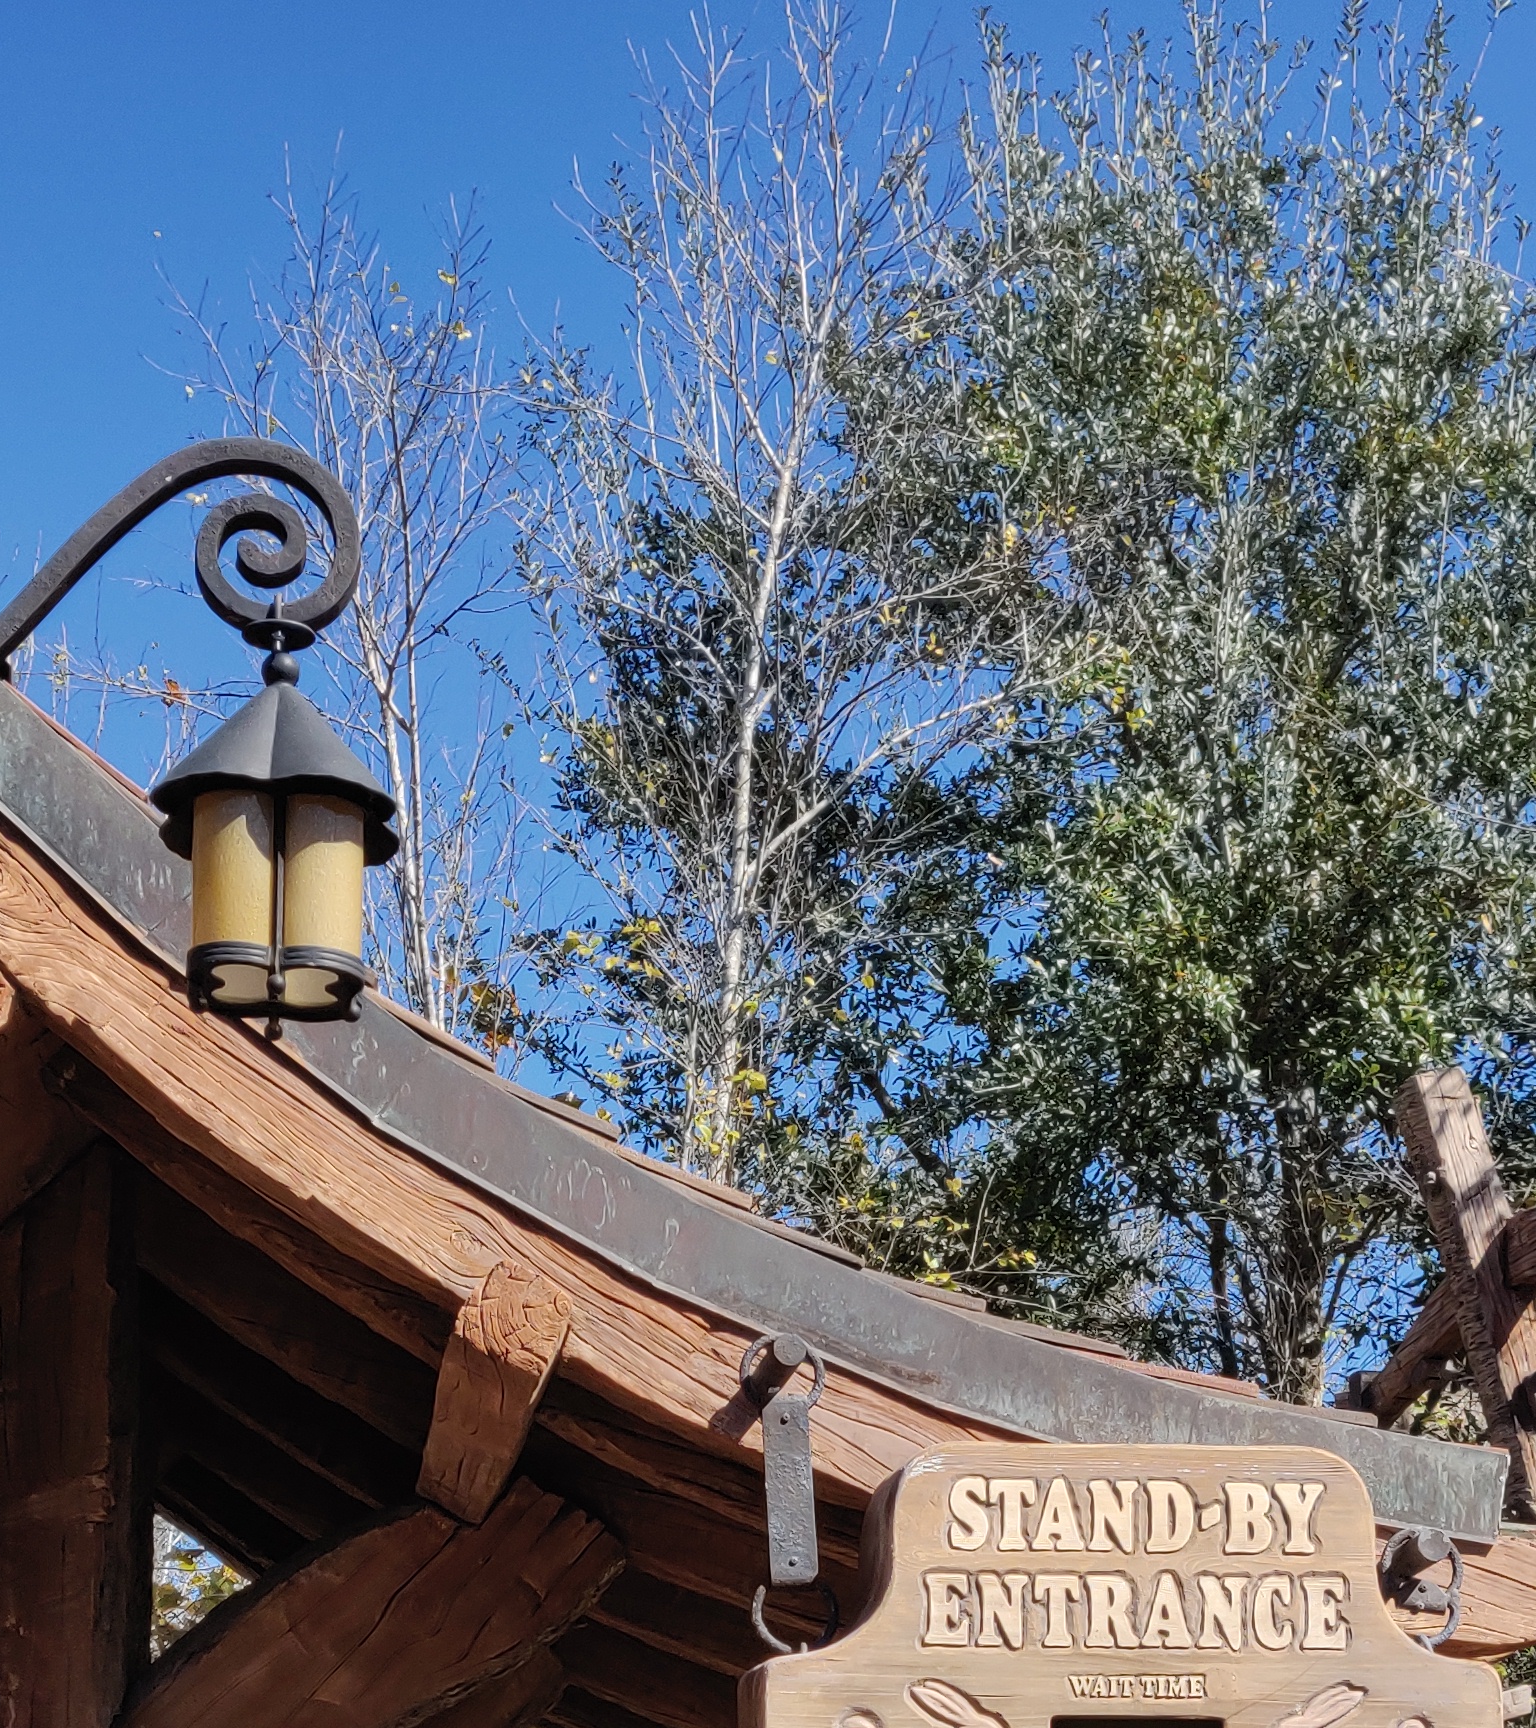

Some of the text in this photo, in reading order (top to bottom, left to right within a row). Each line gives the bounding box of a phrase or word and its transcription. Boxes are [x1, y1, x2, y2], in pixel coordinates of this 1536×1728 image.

[947, 1476, 1325, 1556] STAND-BY
[922, 1570, 1351, 1652] ENTRANCE
[1067, 1675, 1206, 1699] WAIT TIME
